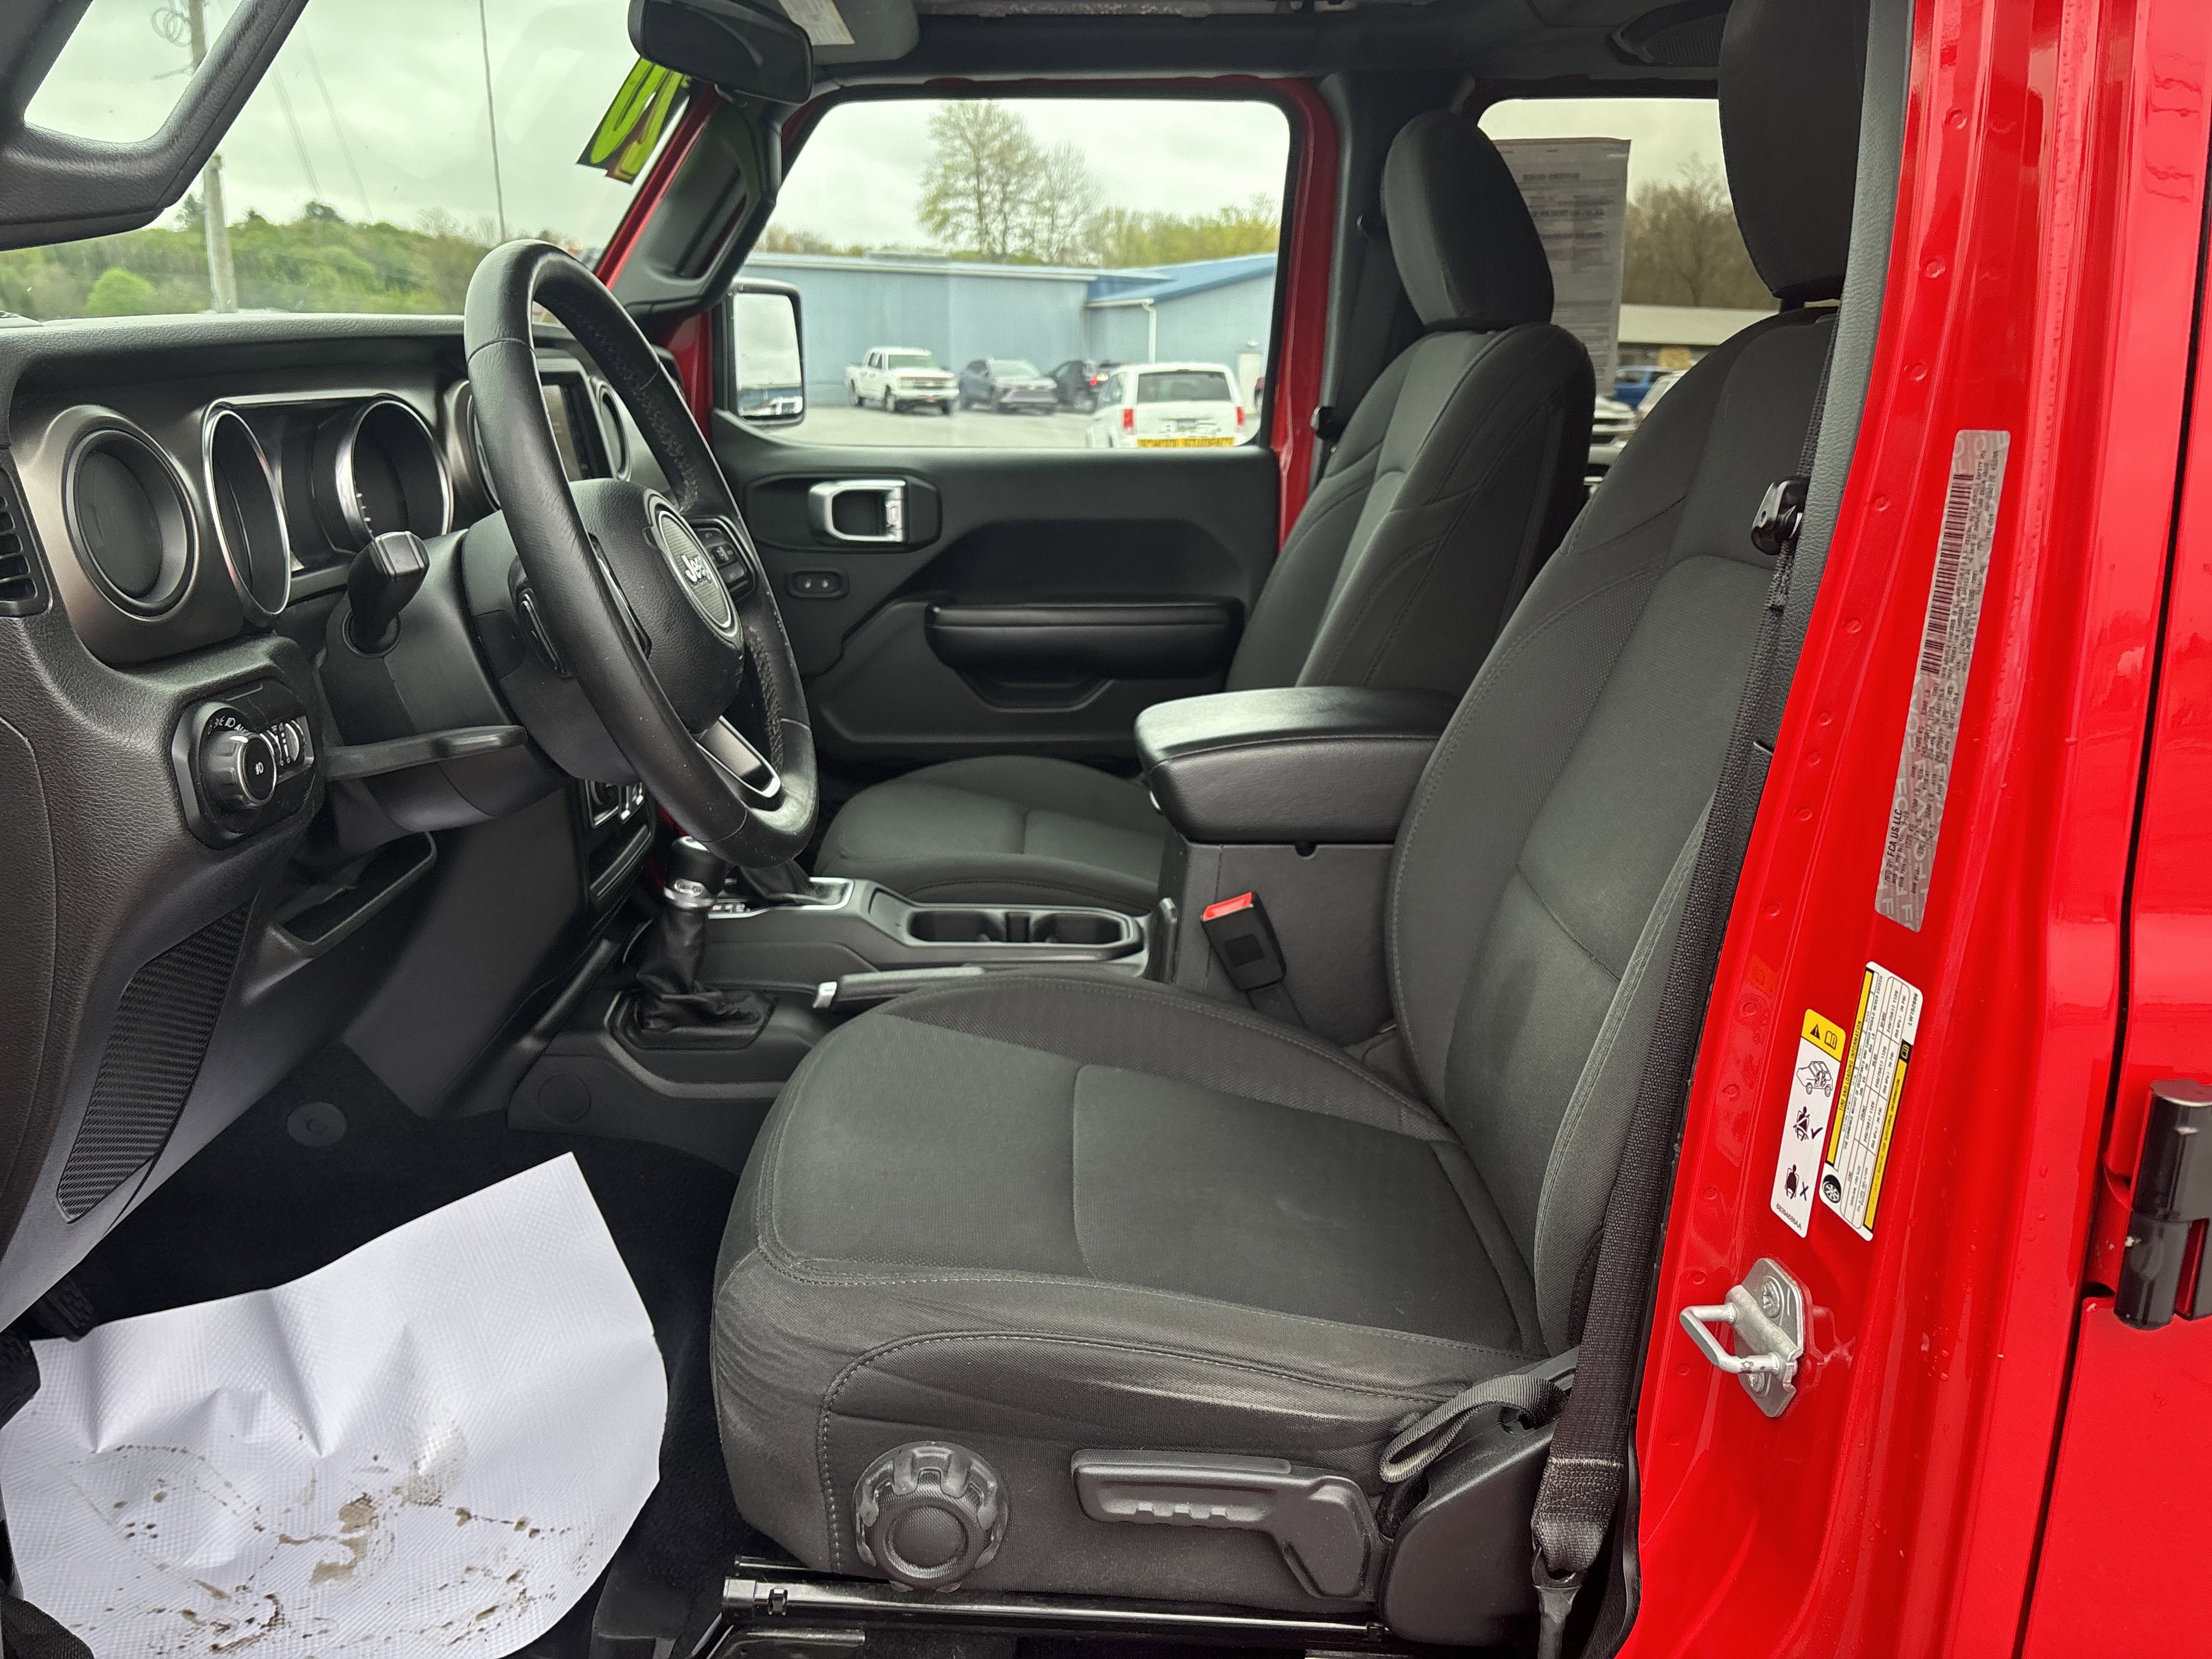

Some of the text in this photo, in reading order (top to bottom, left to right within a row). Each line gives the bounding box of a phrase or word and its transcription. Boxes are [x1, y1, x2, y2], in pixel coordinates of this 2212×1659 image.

[681, 555, 712, 584] Jeep
[1892, 807, 1903, 826] LLC
[1889, 825, 1899, 839] US
[1886, 839, 1897, 857] FCA
[1844, 1058, 1854, 1086] LOADING
[1849, 1019, 1862, 1060] INFORMATION
